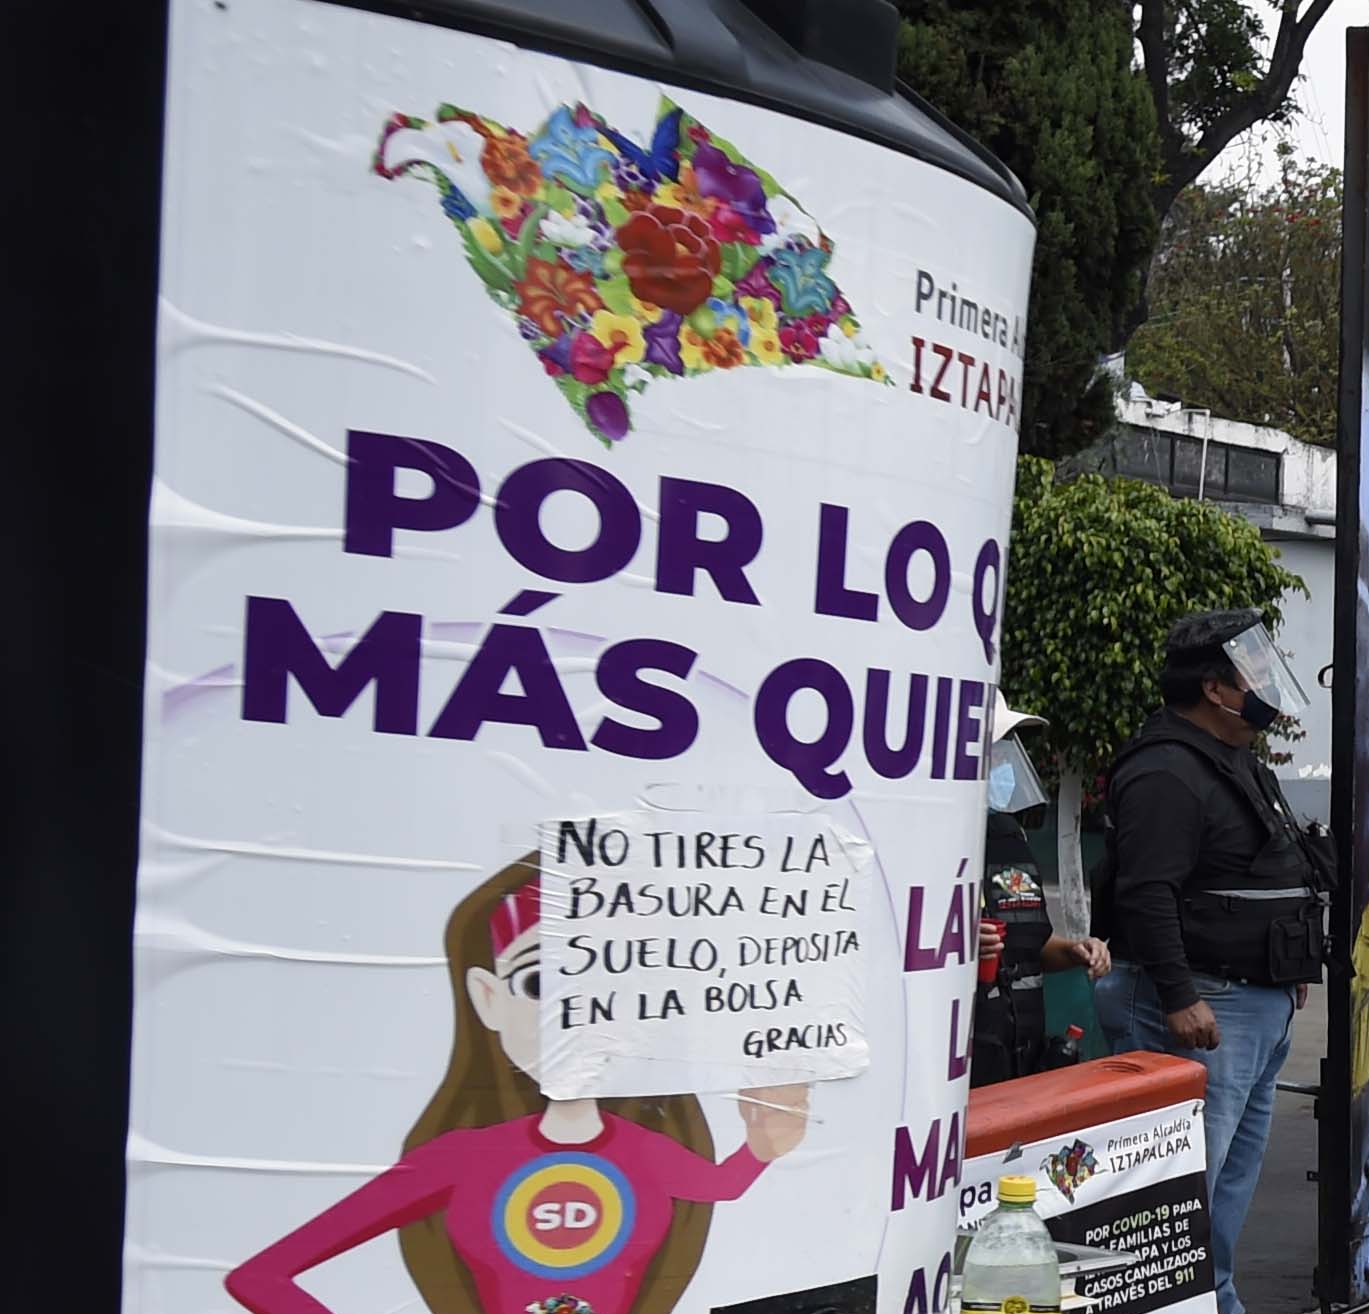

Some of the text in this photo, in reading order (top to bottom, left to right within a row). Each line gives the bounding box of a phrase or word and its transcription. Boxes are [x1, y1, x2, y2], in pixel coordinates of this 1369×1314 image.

[916, 270, 1008, 347] Primera
[343, 428, 763, 606] POR
[814, 502, 951, 632] LO
[240, 588, 700, 760] MÁS
[557, 818, 830, 873] NO TIRES LA
[564, 877, 856, 919] BASURA EN EL
[559, 931, 859, 978] SUELO, DEPOSITA
[560, 979, 803, 1029] EN LA BOLSA
[743, 1023, 847, 1058] GRACIAS
[1107, 1118, 1191, 1152] Primera Alcaldía
[1109, 1138, 1191, 1174] IZTAPALAPA
[891, 1106, 967, 1212] MA
[533, 1202, 597, 1232] SD
[1086, 1198, 1201, 1245] POR COVID-19 PARA
[1175, 1219, 1189, 1232] DE
[1161, 1242, 1169, 1253] Y
[1172, 1236, 1191, 1251] LOS
[1085, 1247, 1206, 1298] CASOS CANALIZADOS
[1097, 1285, 1145, 1311] TRAVÉS
[1148, 1277, 1172, 1294] DEL
[1175, 1267, 1194, 1285] 911
